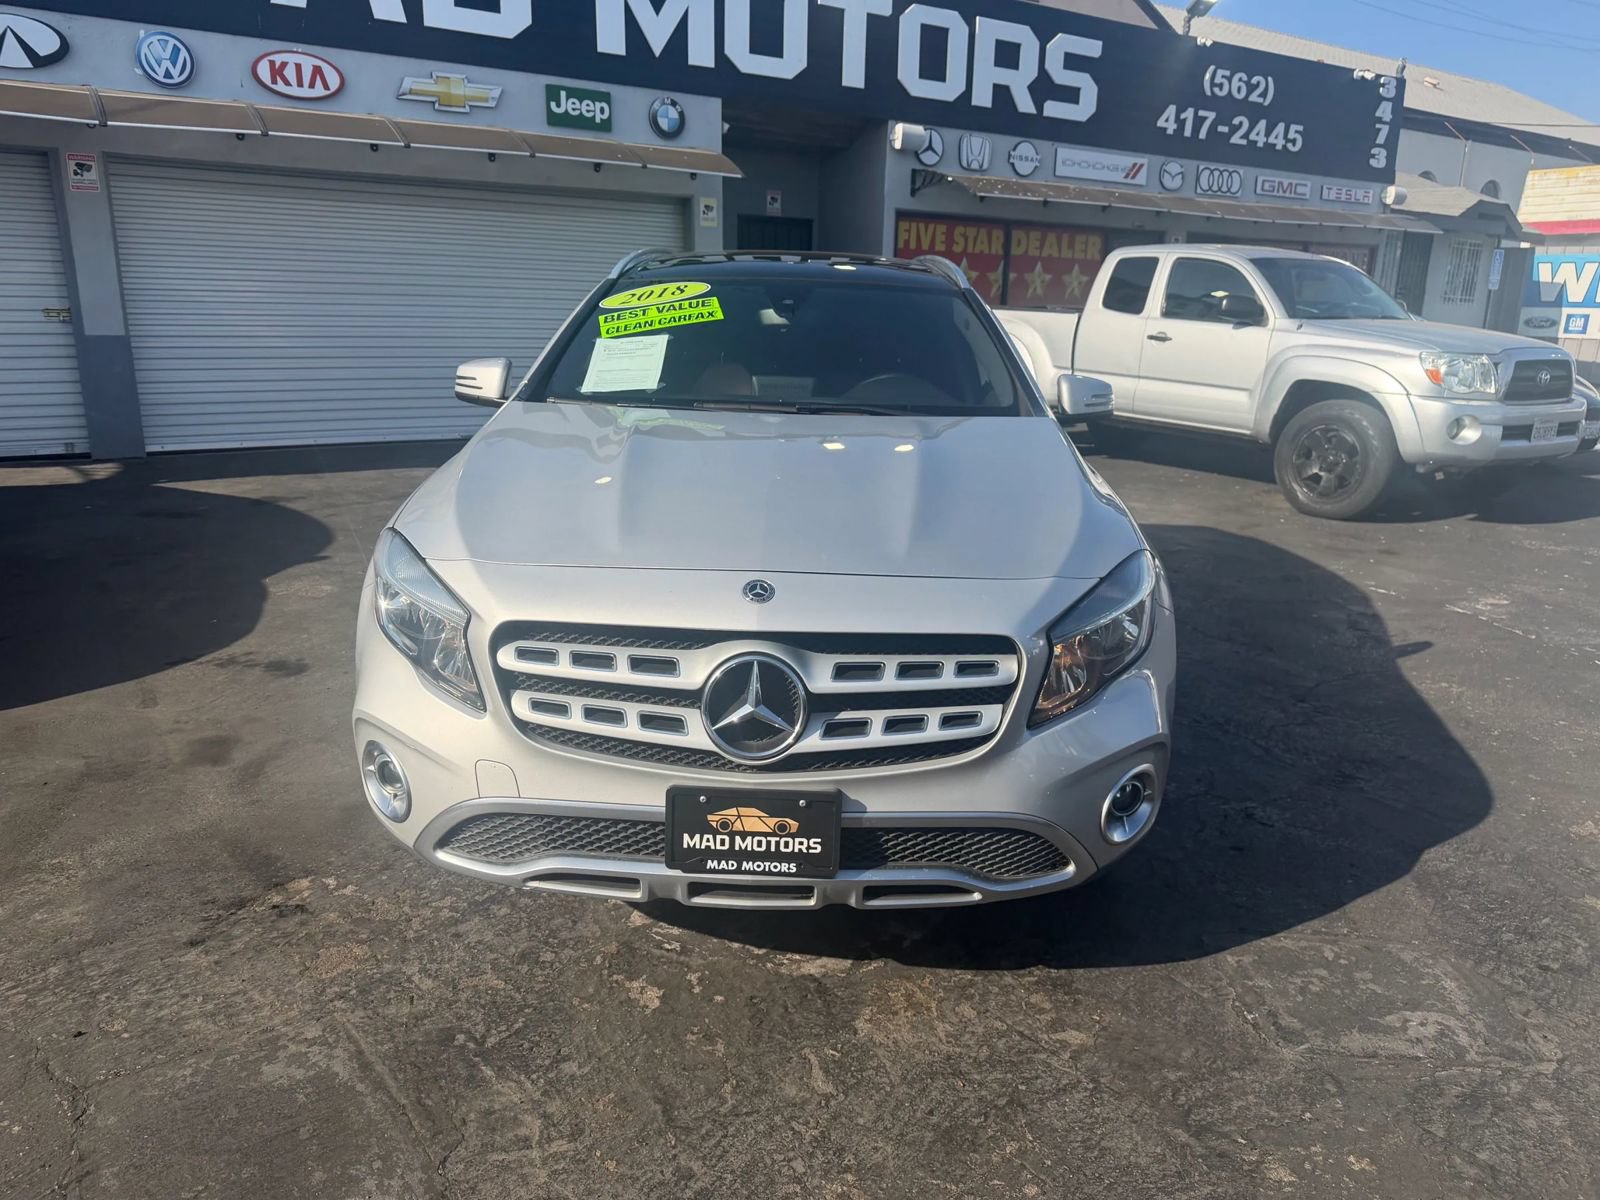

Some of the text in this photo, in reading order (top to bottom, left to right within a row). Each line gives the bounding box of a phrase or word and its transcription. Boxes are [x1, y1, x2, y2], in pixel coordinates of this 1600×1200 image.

[596, 0, 1103, 122] MOTORS
[266, 59, 331, 91] KIA
[1203, 65, 1275, 106] (562)
[550, 90, 610, 125] Jeep
[1157, 104, 1304, 152] 417-2445
[1010, 153, 1040, 164] NISSAN
[1261, 179, 1309, 197] GMC
[1325, 187, 1370, 202] TESLA
[897, 220, 1101, 260] FIVE STAR DEALER
[621, 284, 689, 306] 2018
[603, 298, 713, 324] BEST VALUE
[605, 310, 717, 336] CLEAN CARFAX
[1568, 317, 1585, 328] GM
[683, 833, 822, 854] MAD MOTORS
[706, 859, 797, 873] MAD MOTORS
